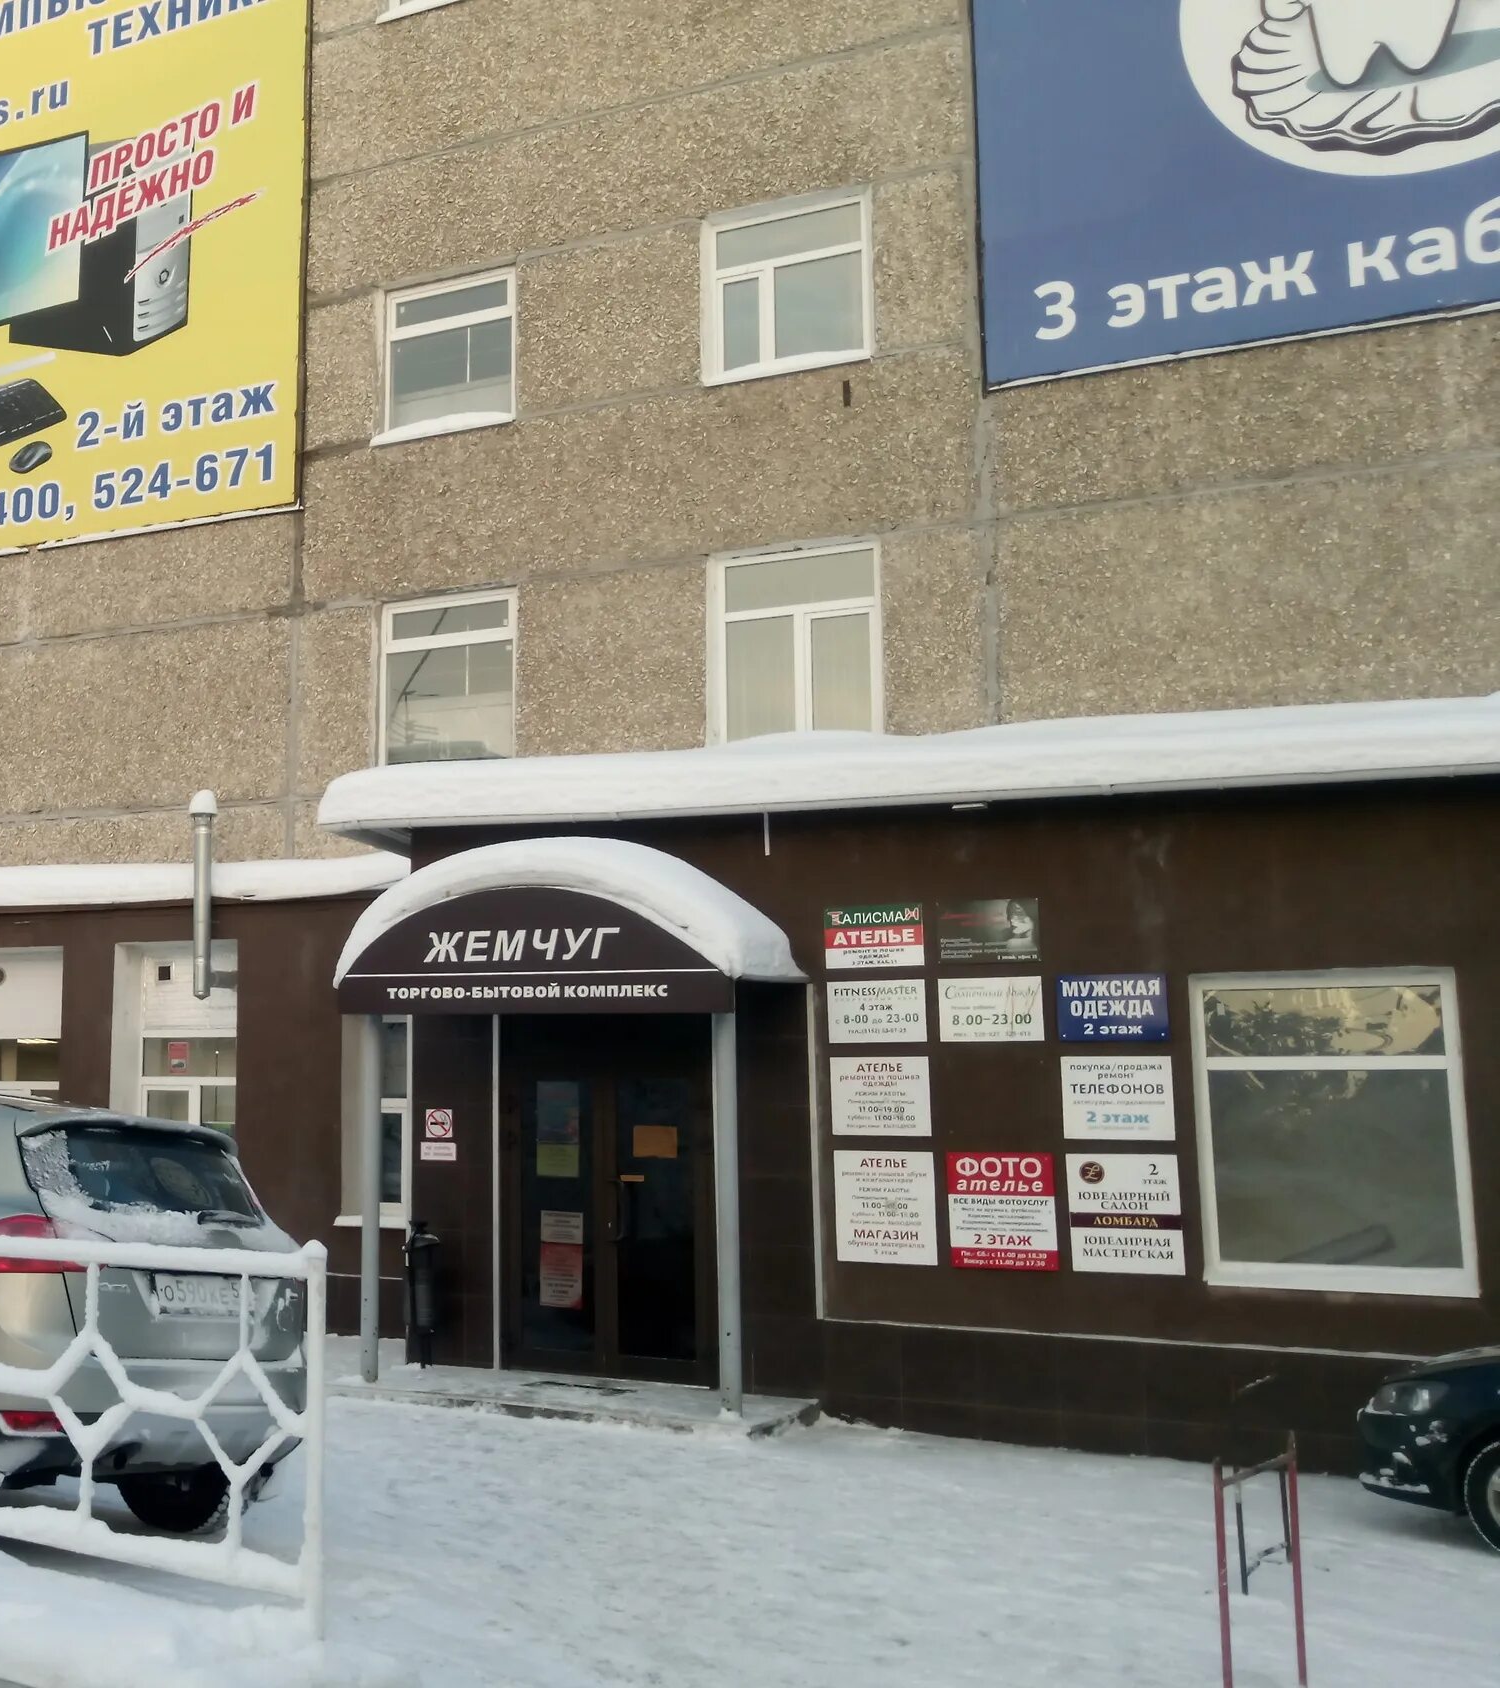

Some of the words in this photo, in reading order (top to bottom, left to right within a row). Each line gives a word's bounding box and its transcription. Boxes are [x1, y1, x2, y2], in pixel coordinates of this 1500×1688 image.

[87, 0, 268, 56] ТЕХНИ
[89, 102, 220, 190] ПРОСТО
[232, 84, 257, 125] И
[47, 148, 215, 252] НАДЁЖНО
[1034, 280, 1077, 341] 3
[1106, 249, 1318, 329] этаж
[77, 403, 145, 449] 2-й
[161, 382, 277, 433] этаж
[94, 444, 275, 510] 524-671
[833, 928, 915, 946] АТЕЛЬЕ
[423, 926, 621, 964] ЖЕМЧУГ
[387, 982, 561, 1000] ТОРГОВО-БЫТОВОЙ
[564, 983, 669, 999] КОМПЛЕКС
[1062, 980, 1161, 997] МУЖСКАЯ
[860, 1003, 865, 1011] 4
[1070, 1000, 1154, 1019] ОДЕЖДА
[843, 1014, 869, 1024] 8-00
[886, 1013, 919, 1023] 23-00
[1083, 1023, 1094, 1035] 2
[1099, 1024, 1143, 1035] этаж
[857, 1063, 903, 1072] АТЕЛЬЕ
[1069, 1063, 1162, 1072] покупка/продажа
[1070, 1084, 1164, 1094] ТЕЛЕФОНОВ
[1086, 1110, 1096, 1123] 2
[1101, 1113, 1150, 1123] этаж
[860, 1158, 908, 1168] АТЕЛЬЕ
[955, 1157, 1042, 1178] ФОТО
[1148, 1163, 1159, 1176] 2
[956, 1179, 1044, 1192] ателье
[971, 1198, 996, 1206] ВИДЫ
[998, 1199, 1049, 1207] ФОТОУСЛУГ
[1078, 1191, 1170, 1201] ЮВЕЛИРНЫЙ
[1100, 1201, 1149, 1210] САЛОН
[1093, 1216, 1159, 1228] ЛОМБАРД
[854, 1229, 919, 1240] МАГАЗИН
[974, 1234, 982, 1245] 2
[987, 1234, 1032, 1246] ЭТАЖ
[1084, 1235, 1171, 1247] ЮВЕЛИРНАЯ
[1082, 1247, 1174, 1260] МАСТЕРСКАЯ
